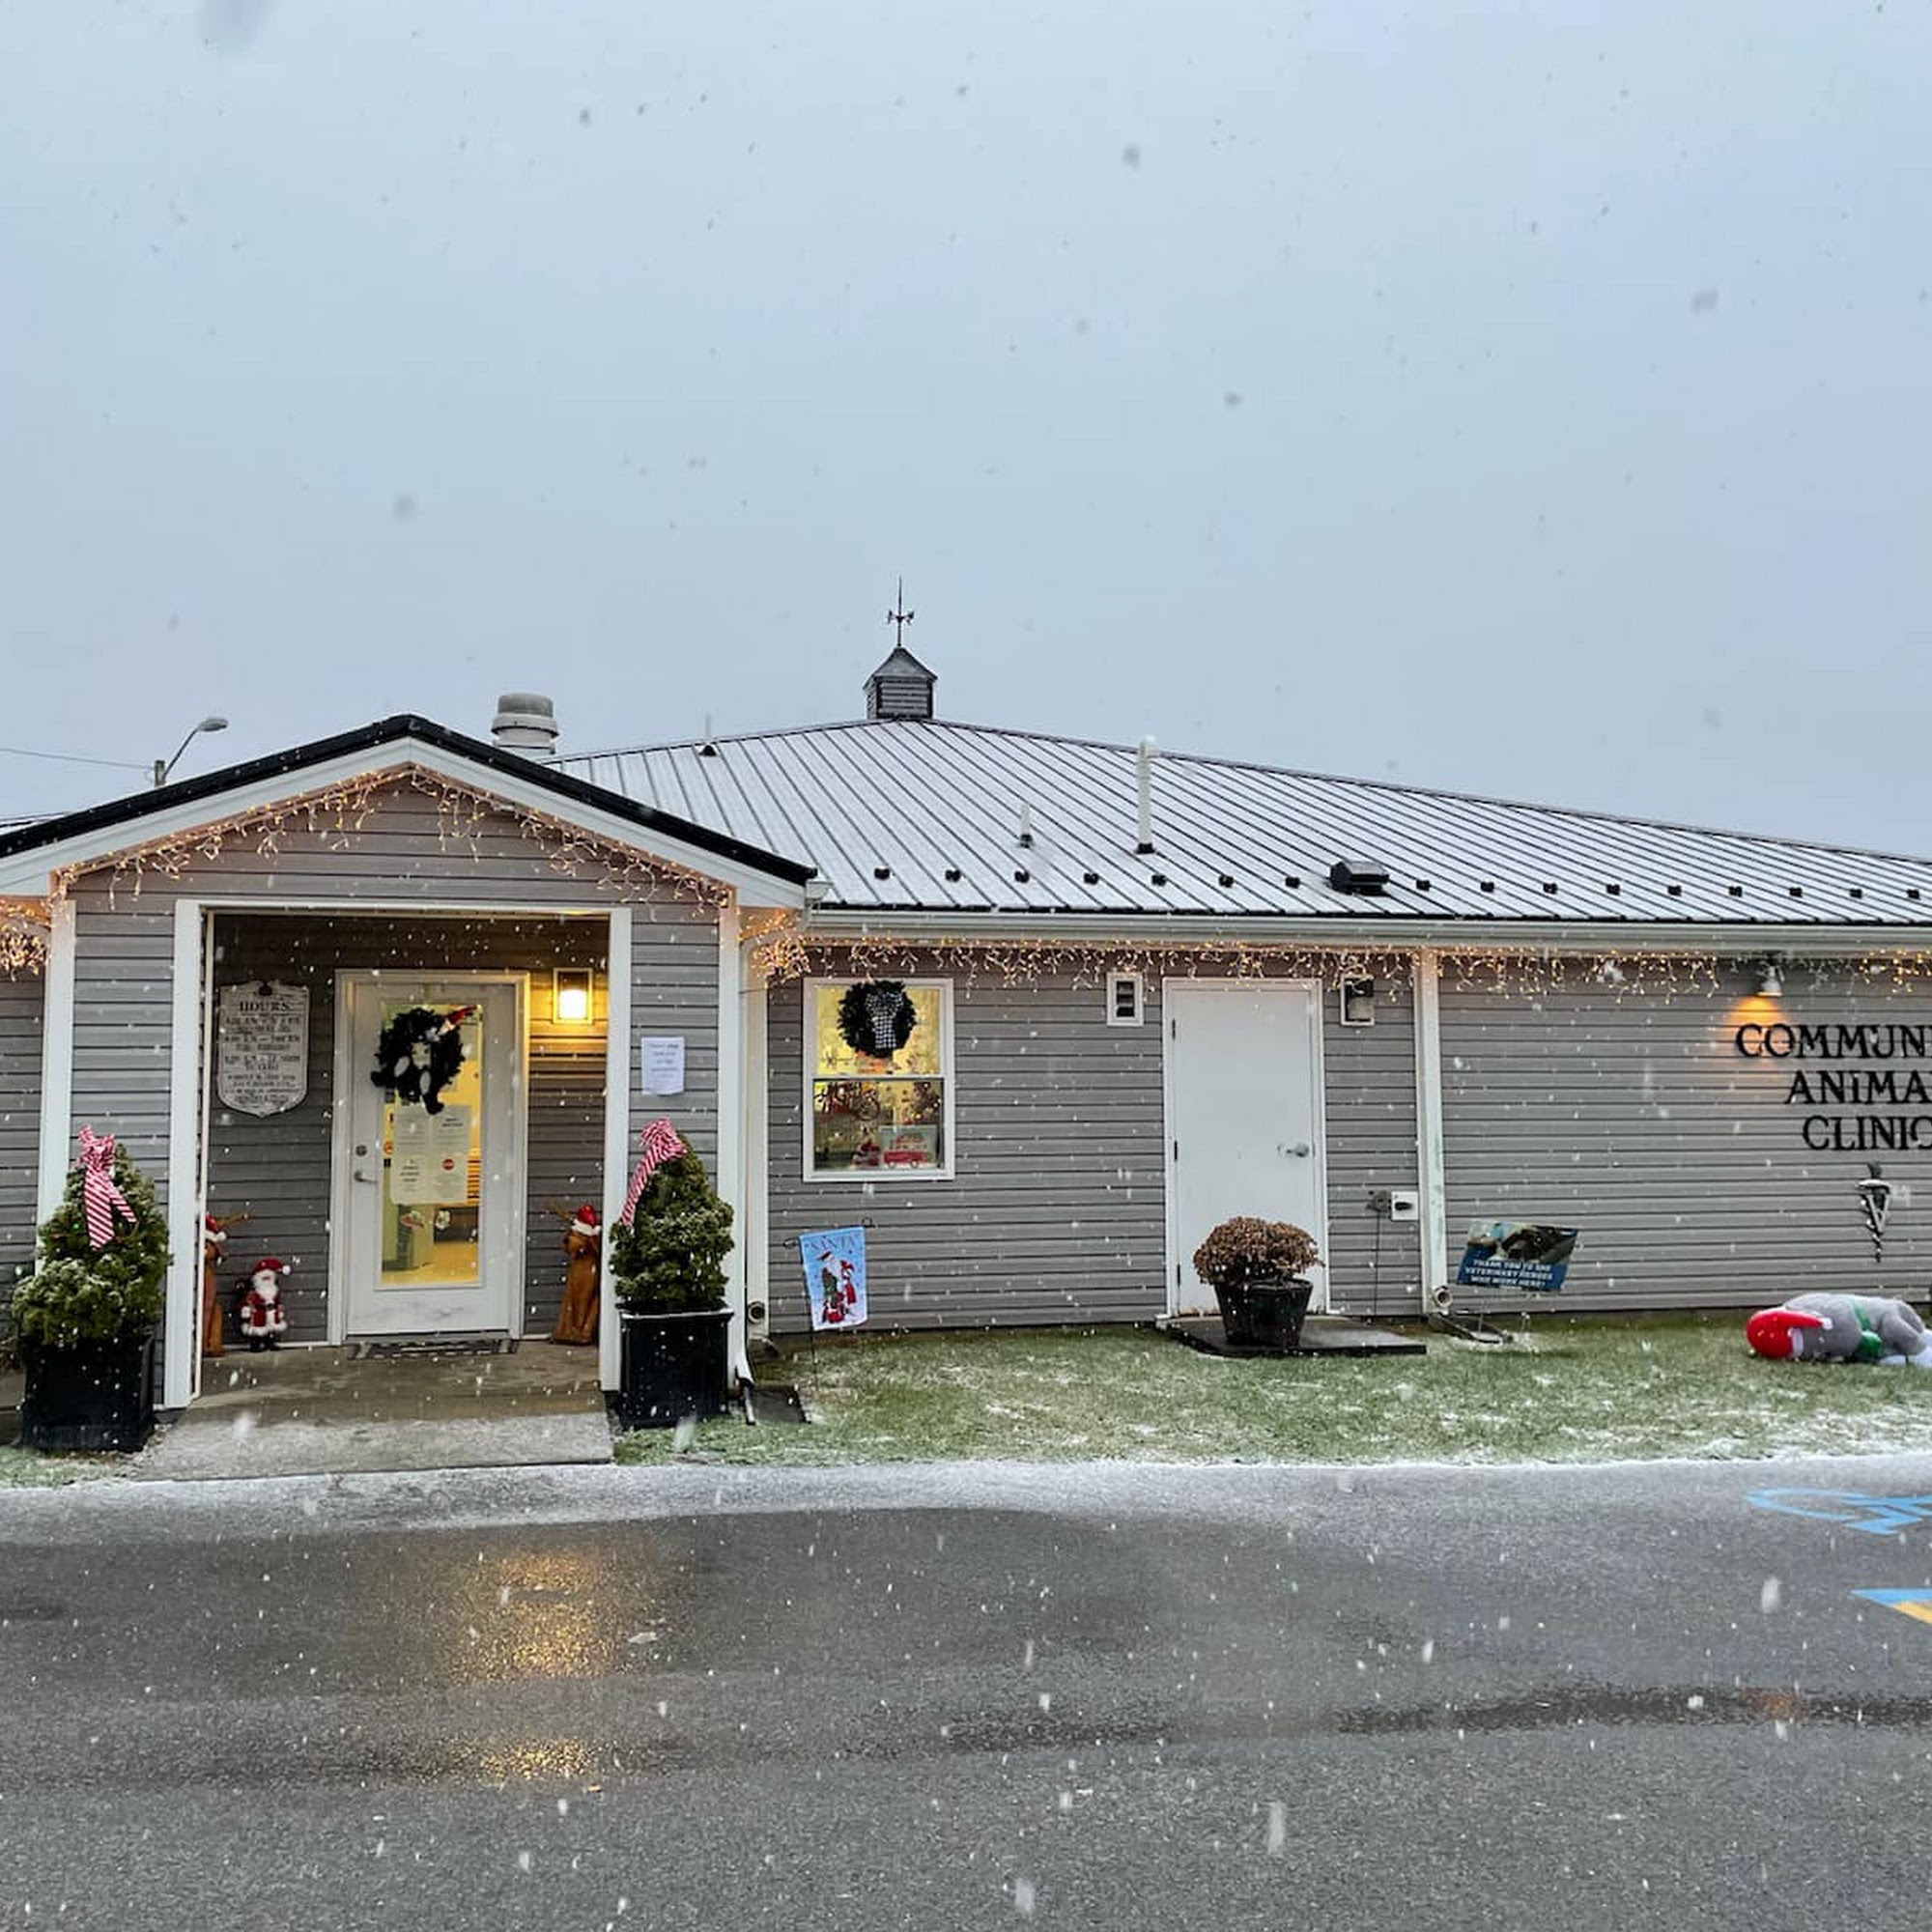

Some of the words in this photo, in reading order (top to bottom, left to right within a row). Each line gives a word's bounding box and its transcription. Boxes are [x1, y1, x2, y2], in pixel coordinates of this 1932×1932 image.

[239, 1001, 291, 1011] HOURS
[1736, 1024, 1932, 1058] COMMUN
[1784, 1069, 1932, 1104] ANIMA
[1473, 1260, 1502, 1269] THANK
[1503, 1262, 1521, 1270] YOU
[1521, 1263, 1534, 1271] TO
[1464, 1266, 1520, 1277] VETERINARY
[1519, 1271, 1554, 1280] HEROES
